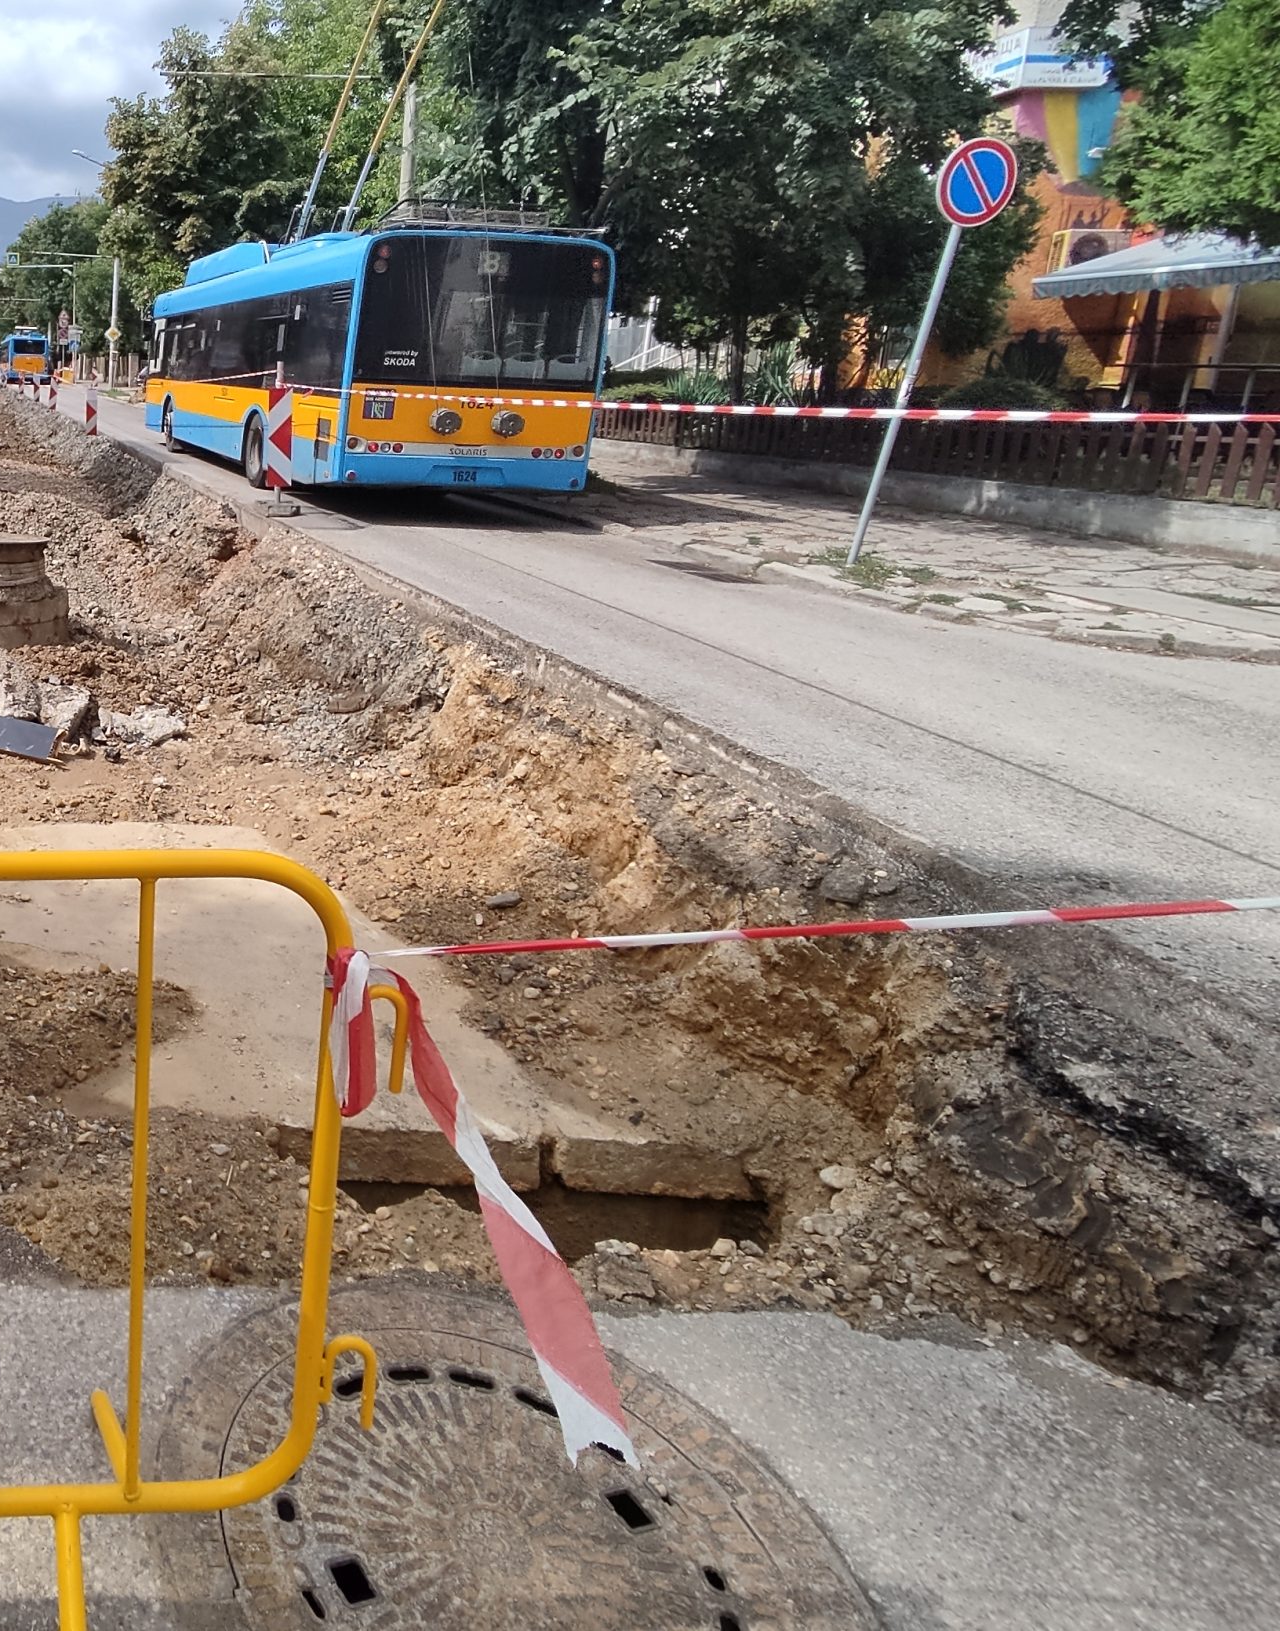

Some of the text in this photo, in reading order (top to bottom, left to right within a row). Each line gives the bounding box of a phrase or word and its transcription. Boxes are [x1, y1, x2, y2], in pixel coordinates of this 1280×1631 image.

[383, 357, 416, 367] SKODA
[448, 448, 488, 456] SOLARIS
[452, 471, 478, 482] 1624
